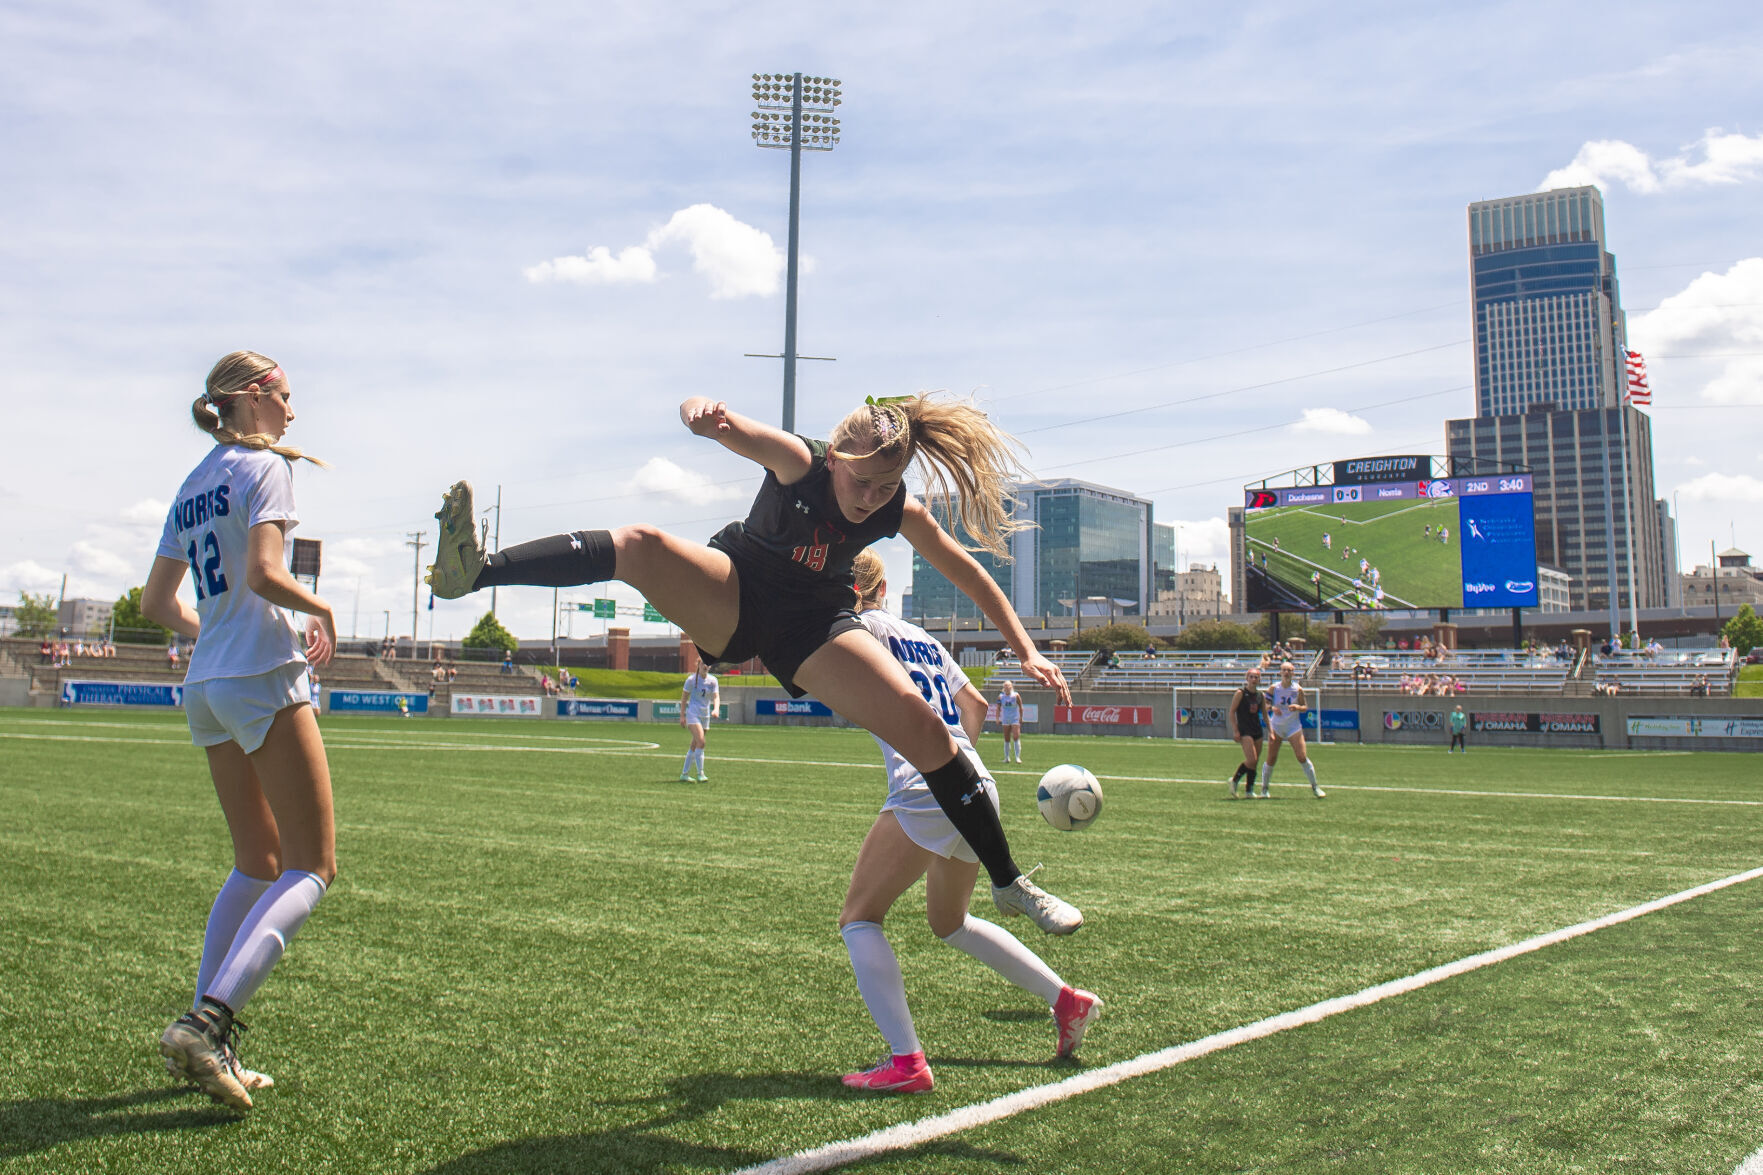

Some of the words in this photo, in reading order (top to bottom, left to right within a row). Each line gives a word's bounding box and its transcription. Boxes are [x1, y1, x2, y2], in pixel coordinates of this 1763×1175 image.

[1346, 457, 1417, 473] CREIGHTON
[1288, 493, 1325, 502] Duchesne
[1466, 482, 1489, 492] 2ND
[1499, 478, 1523, 491] 3:40
[187, 530, 228, 601] 12
[792, 544, 829, 572] 18
[343, 694, 358, 704] MD
[361, 695, 391, 706] WEST
[1485, 721, 1528, 730] OMAHA
[1550, 722, 1595, 732] OMAHA
